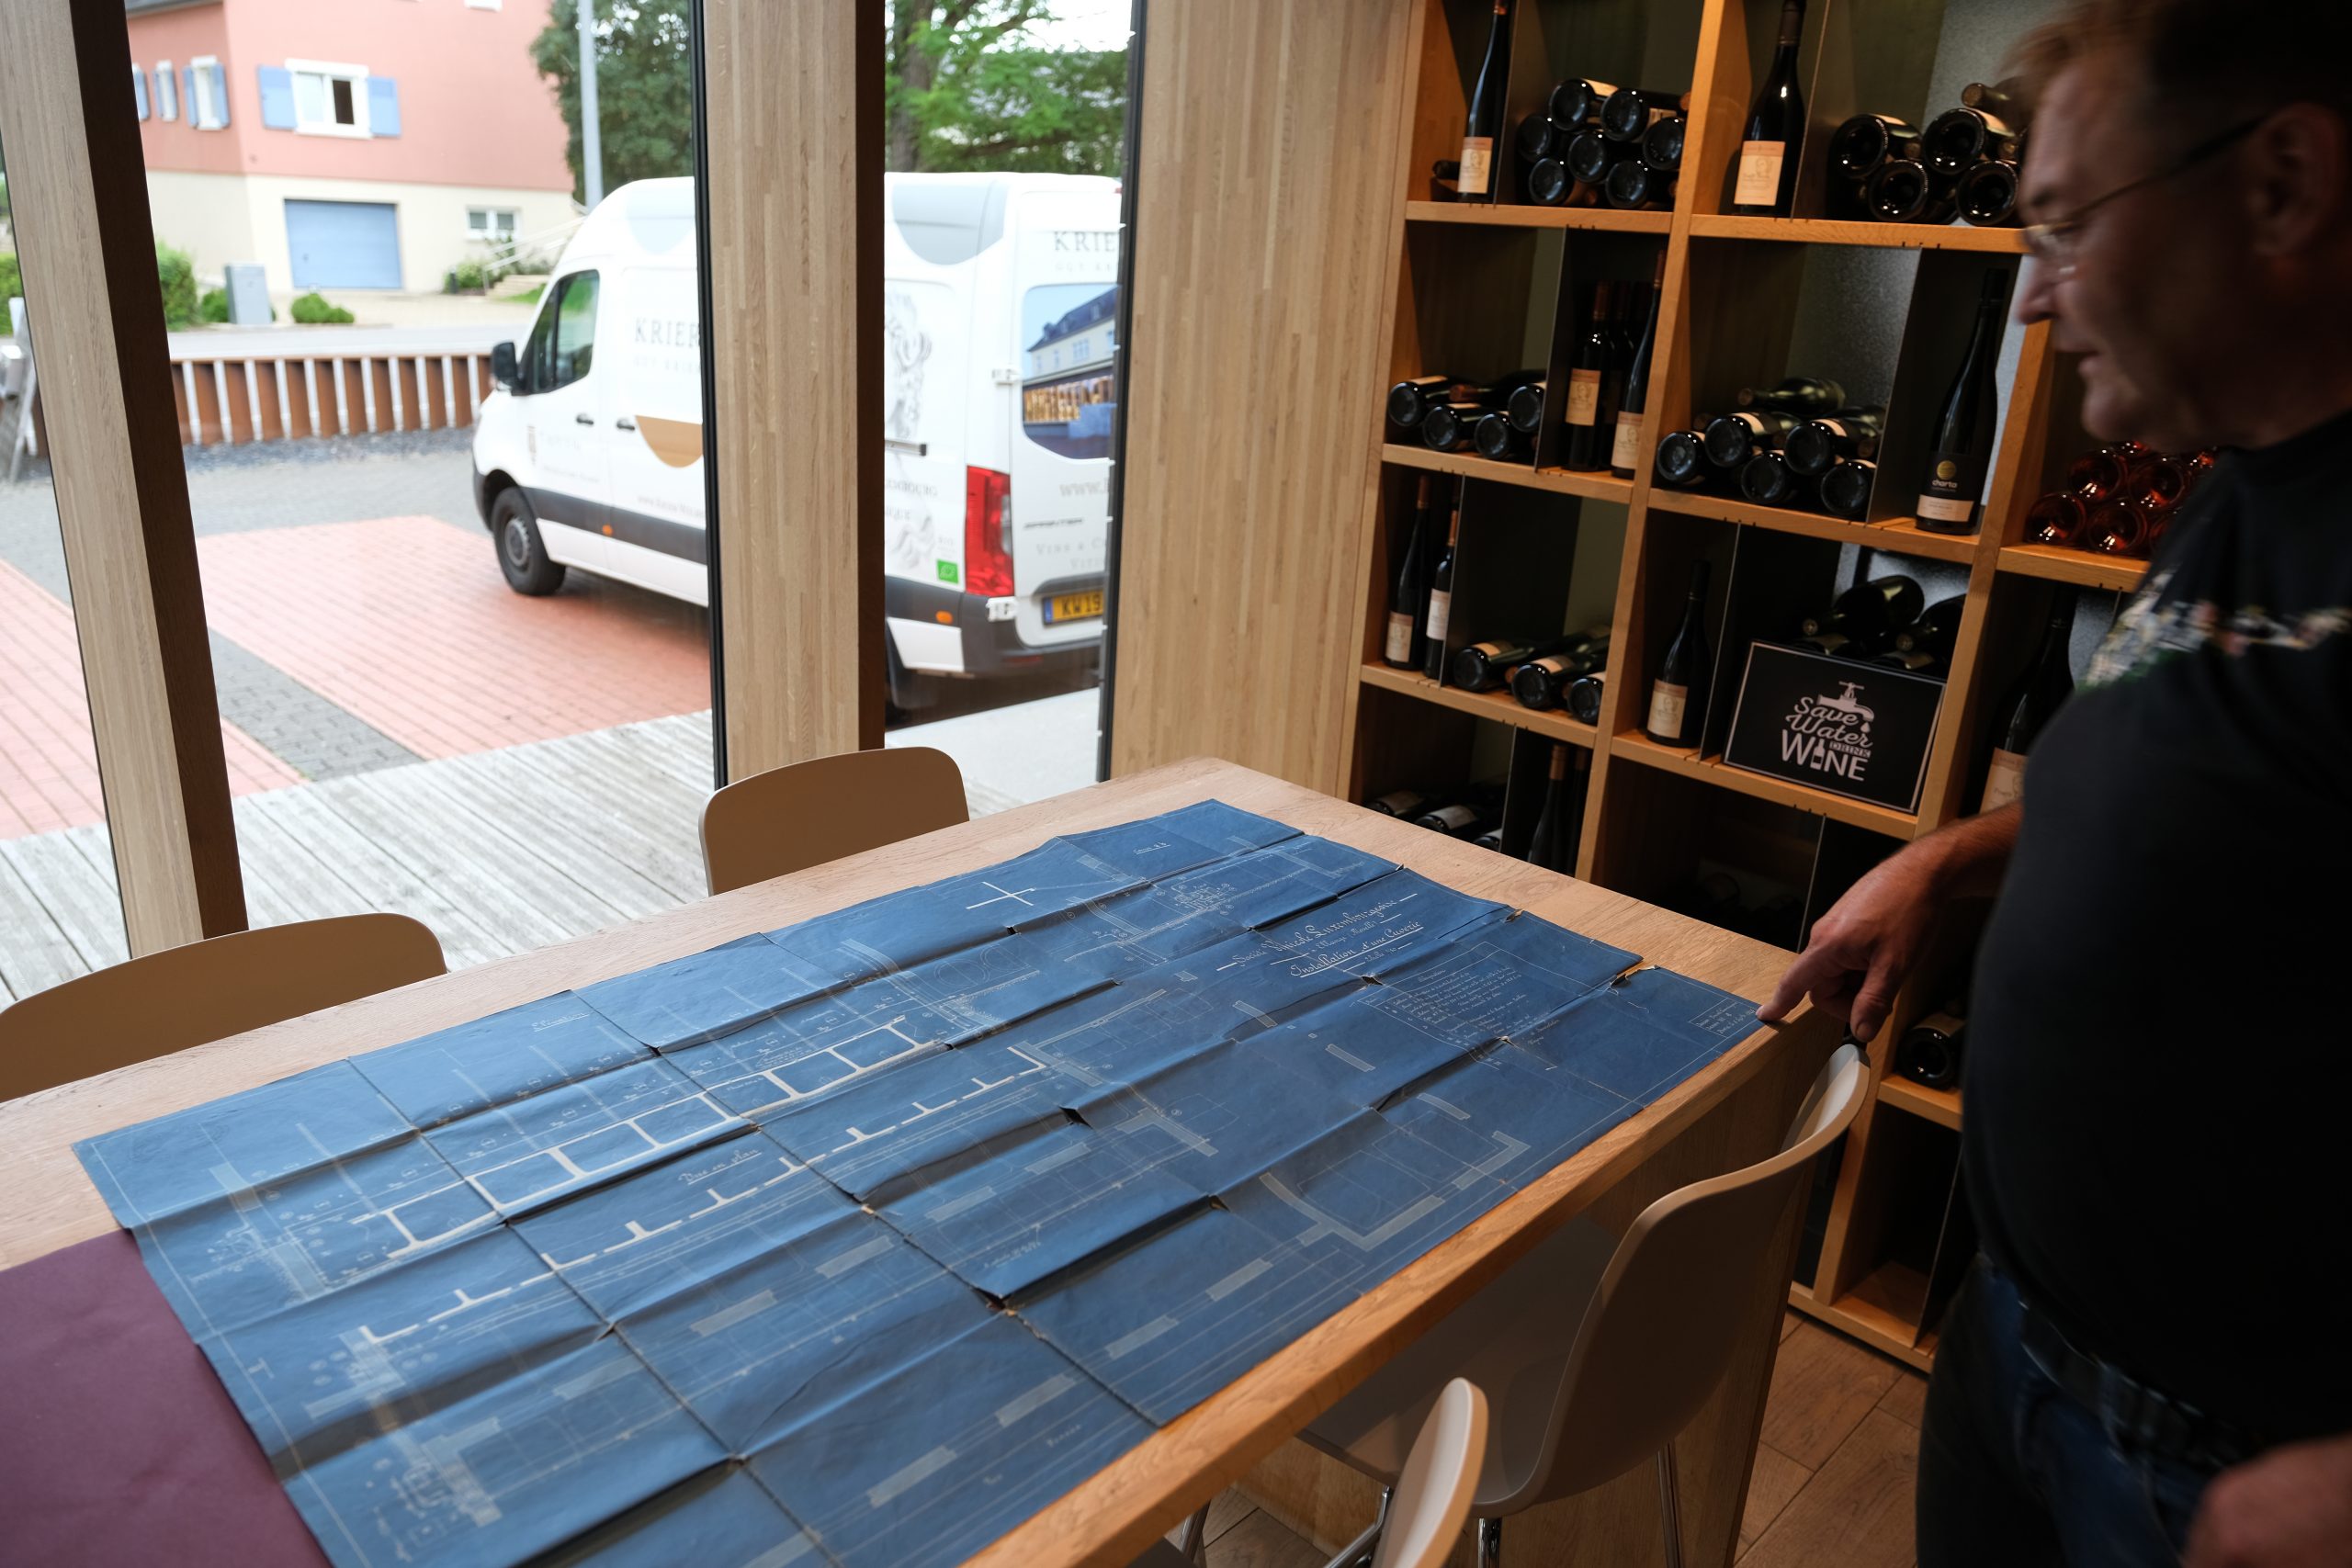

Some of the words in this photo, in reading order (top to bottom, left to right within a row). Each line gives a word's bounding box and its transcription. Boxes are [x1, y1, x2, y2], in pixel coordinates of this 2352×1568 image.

[1793, 696, 1860, 727] Save
[1785, 713, 1873, 749] Water
[1781, 728, 1869, 782] WINE
[1290, 949, 1357, 976] Installation
